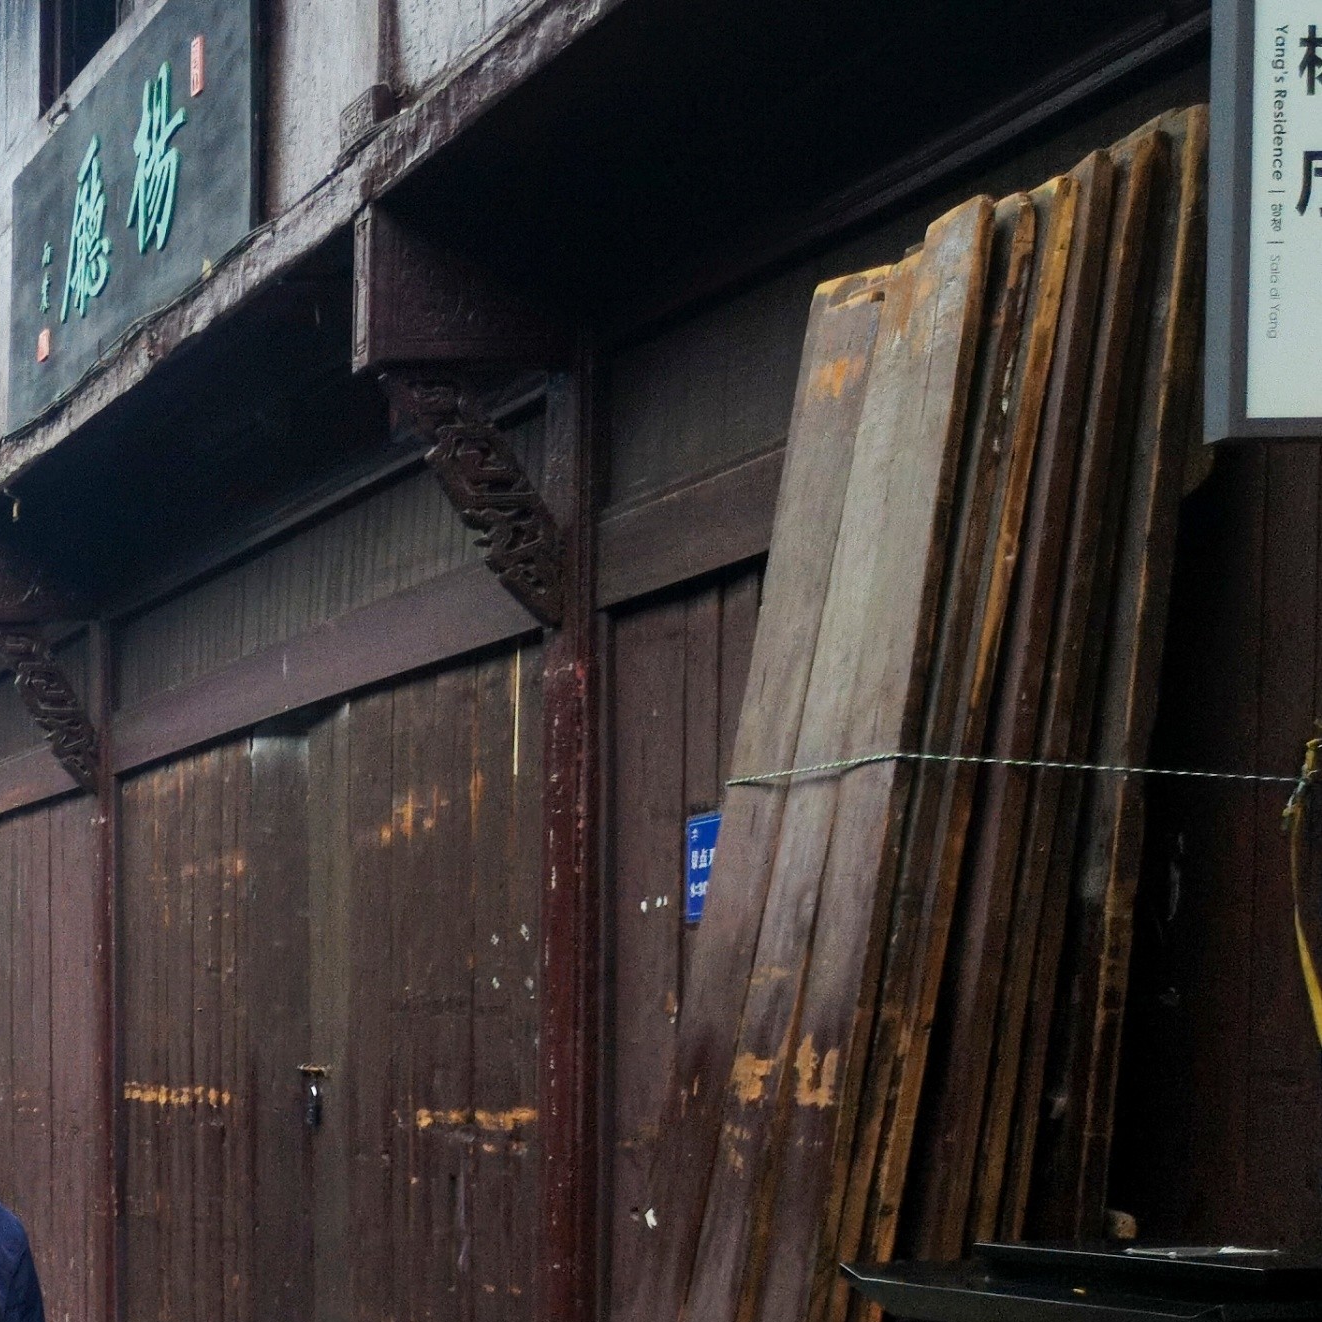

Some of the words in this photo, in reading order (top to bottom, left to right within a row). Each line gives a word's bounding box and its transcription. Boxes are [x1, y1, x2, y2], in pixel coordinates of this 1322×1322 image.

[1271, 24, 1289, 83] Yang's
[1272, 89, 1287, 180] Residence
[1269, 254, 1281, 284] Sala
[1266, 303, 1281, 339] Yang
